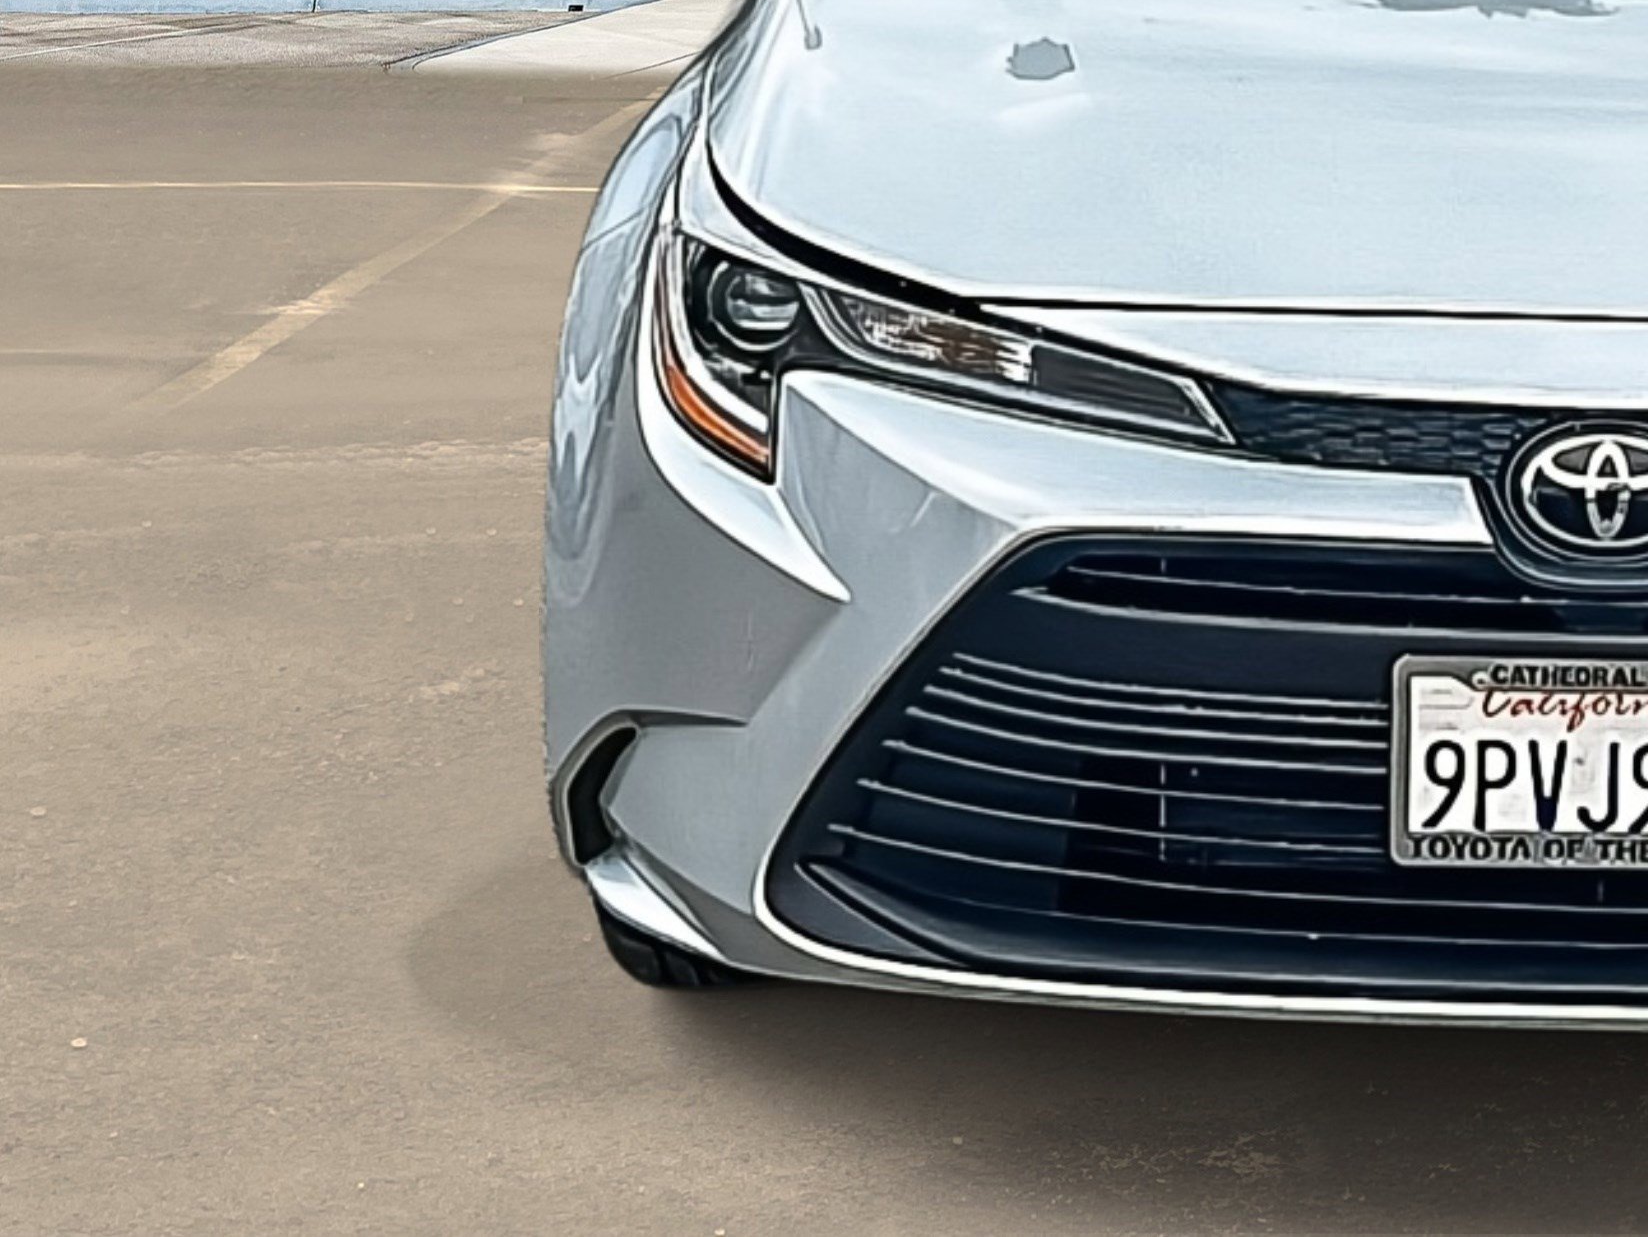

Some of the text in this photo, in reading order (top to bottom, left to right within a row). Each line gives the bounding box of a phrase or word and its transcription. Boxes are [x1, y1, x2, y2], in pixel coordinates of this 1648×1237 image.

[1490, 664, 1646, 688] CATHEDRAL
[1409, 836, 1532, 862] TOYOTA
[1542, 838, 1587, 862] OF
